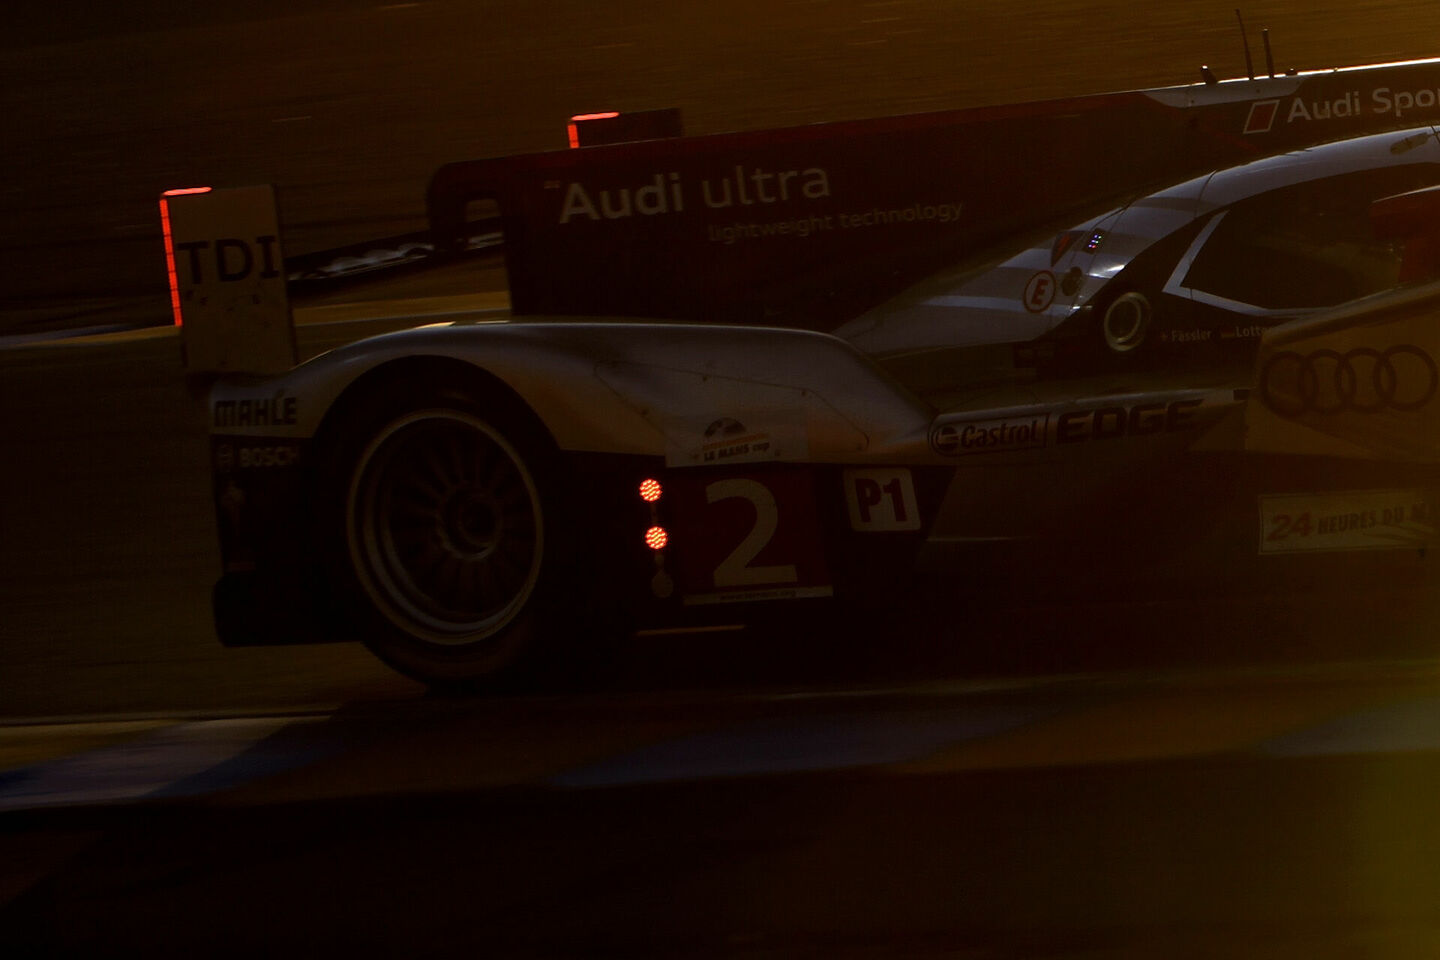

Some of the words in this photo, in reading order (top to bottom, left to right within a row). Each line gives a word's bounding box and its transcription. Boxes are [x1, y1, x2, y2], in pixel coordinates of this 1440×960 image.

[1287, 90, 1362, 124] Audi
[558, 172, 685, 225] Audi
[701, 163, 831, 210] ultra
[707, 213, 834, 246] lightweight
[839, 200, 964, 232] technology
[176, 235, 280, 285] TDI
[214, 396, 297, 427] MAHLE
[960, 419, 1038, 448] Castrol
[1055, 398, 1206, 445] EDGE
[854, 476, 909, 523] P1
[1265, 511, 1315, 541] 24
[1317, 509, 1377, 534] HEURES
[1382, 505, 1405, 526] DU
[704, 477, 799, 588] 2
